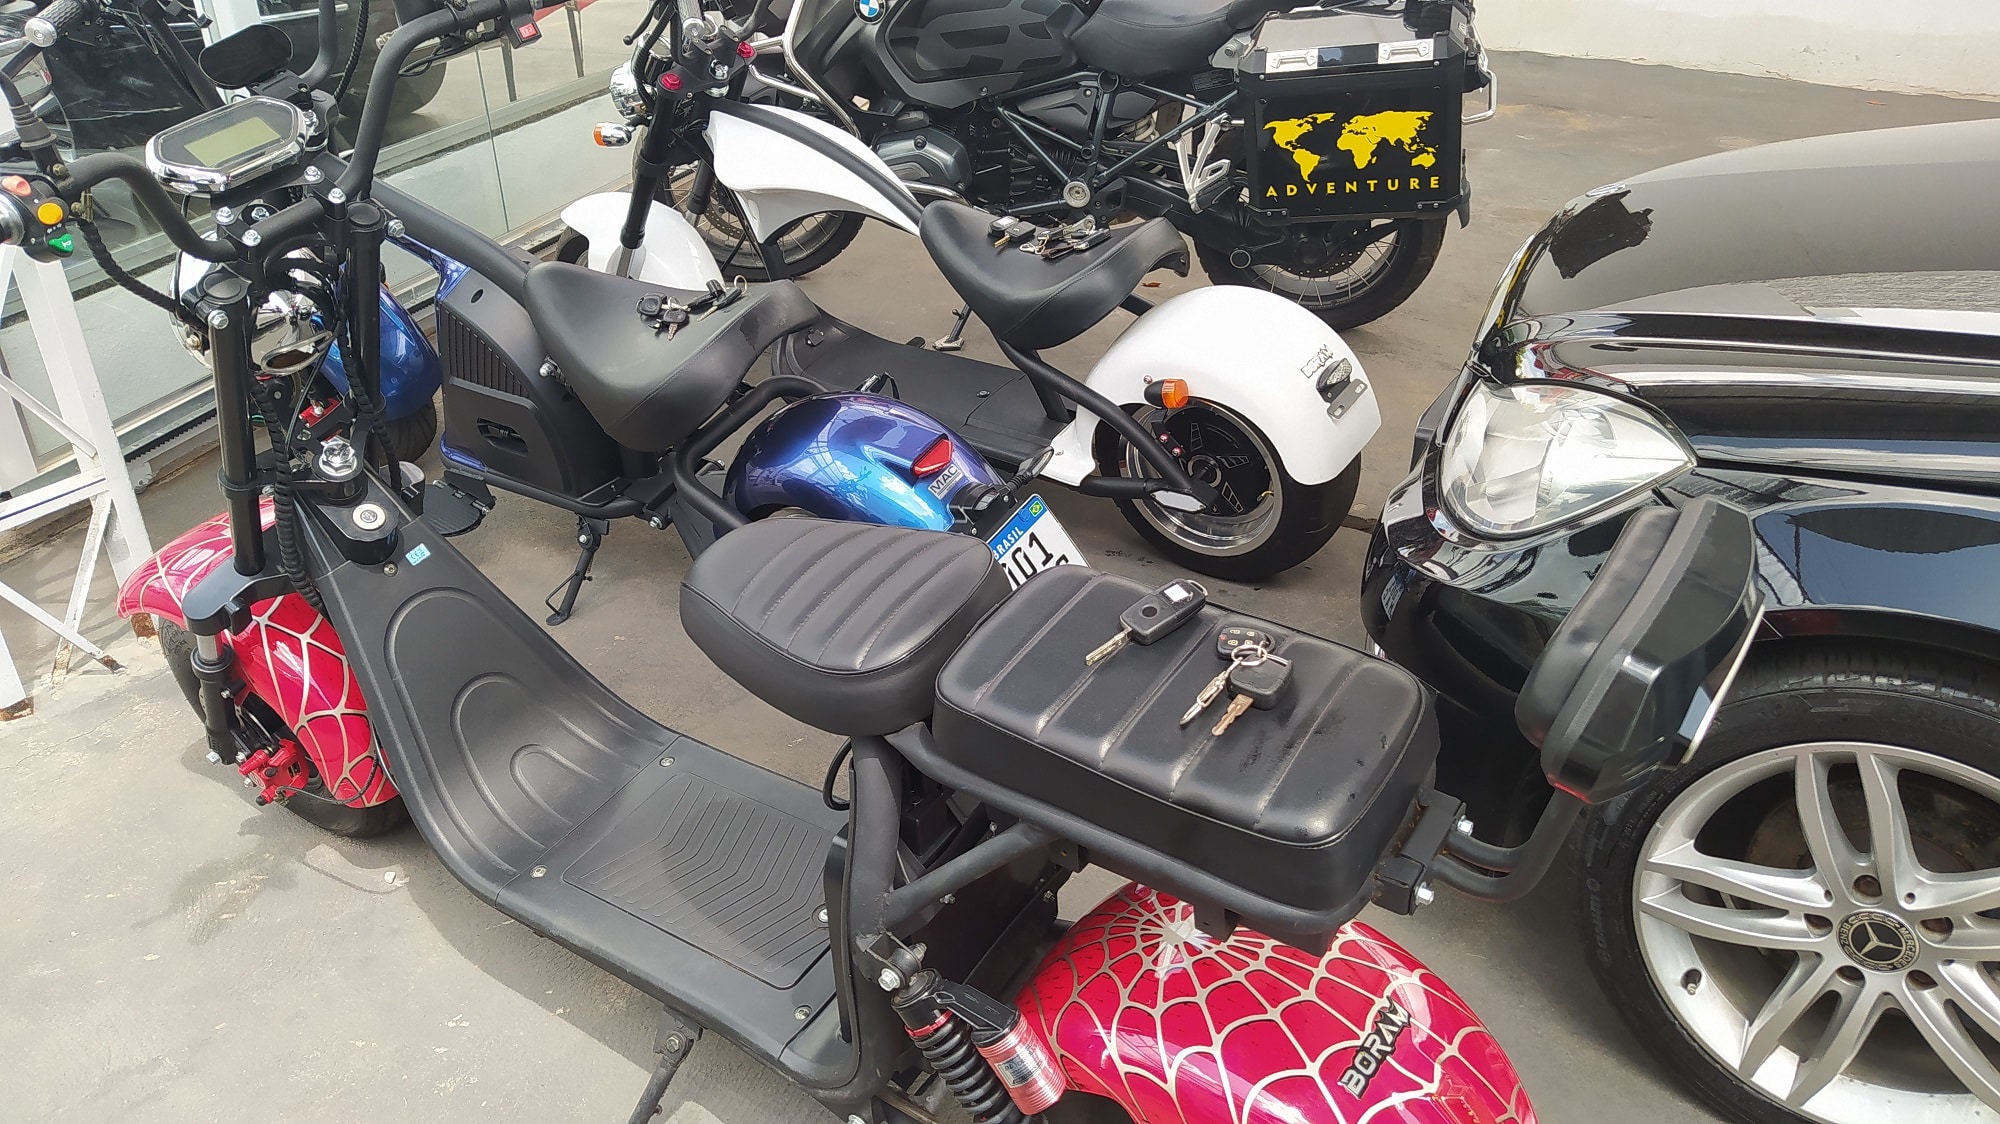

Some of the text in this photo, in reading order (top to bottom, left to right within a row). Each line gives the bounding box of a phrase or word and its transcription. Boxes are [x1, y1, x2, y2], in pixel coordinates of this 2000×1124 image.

[1266, 176, 1440, 198] ADVENTURE
[930, 465, 958, 493] MAC
[1839, 922, 1852, 946] BENZ
[1893, 927, 1916, 969] MERCEDES
[1340, 997, 1410, 1097] BORAM
